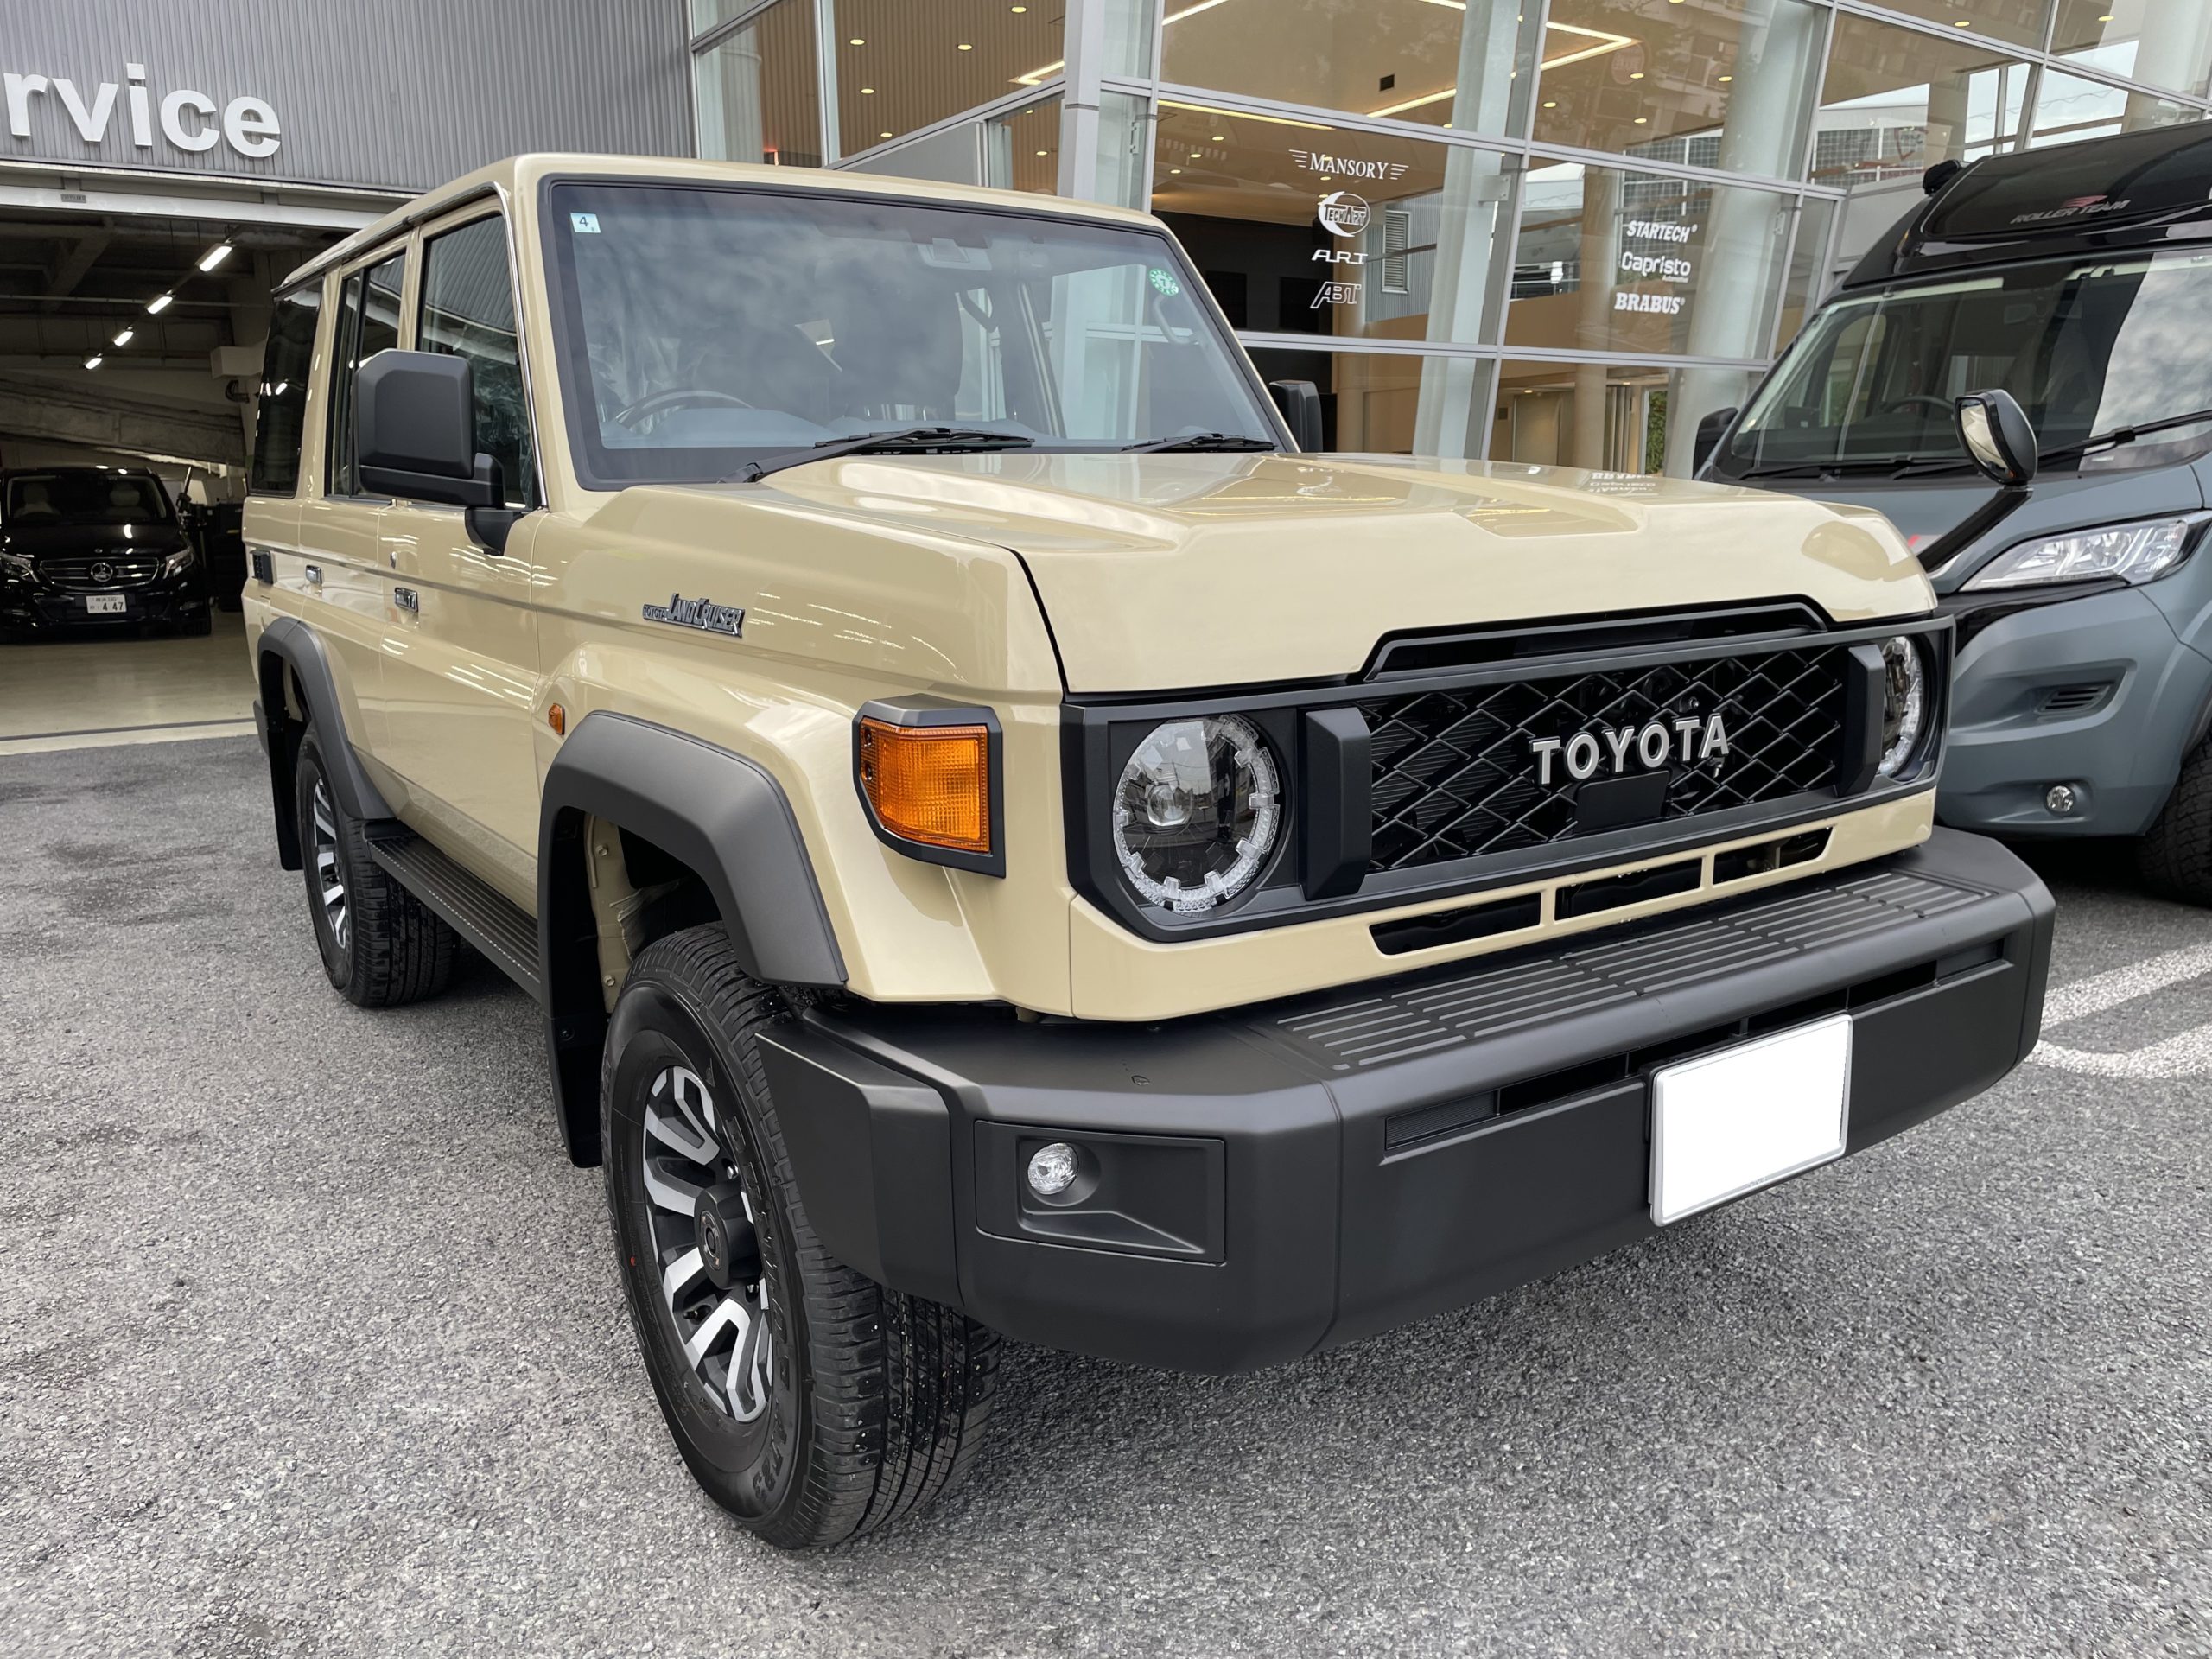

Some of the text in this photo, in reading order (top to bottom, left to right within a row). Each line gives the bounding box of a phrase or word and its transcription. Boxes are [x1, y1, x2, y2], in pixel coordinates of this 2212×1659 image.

[3, 63, 281, 158] rvice
[1309, 152, 1389, 180] MANSORY
[579, 216, 589, 227] 4
[2010, 200, 2131, 224] ROLLER TEAM
[1621, 251, 1691, 276] Capristo
[1530, 712, 1729, 785] TOYOTA
